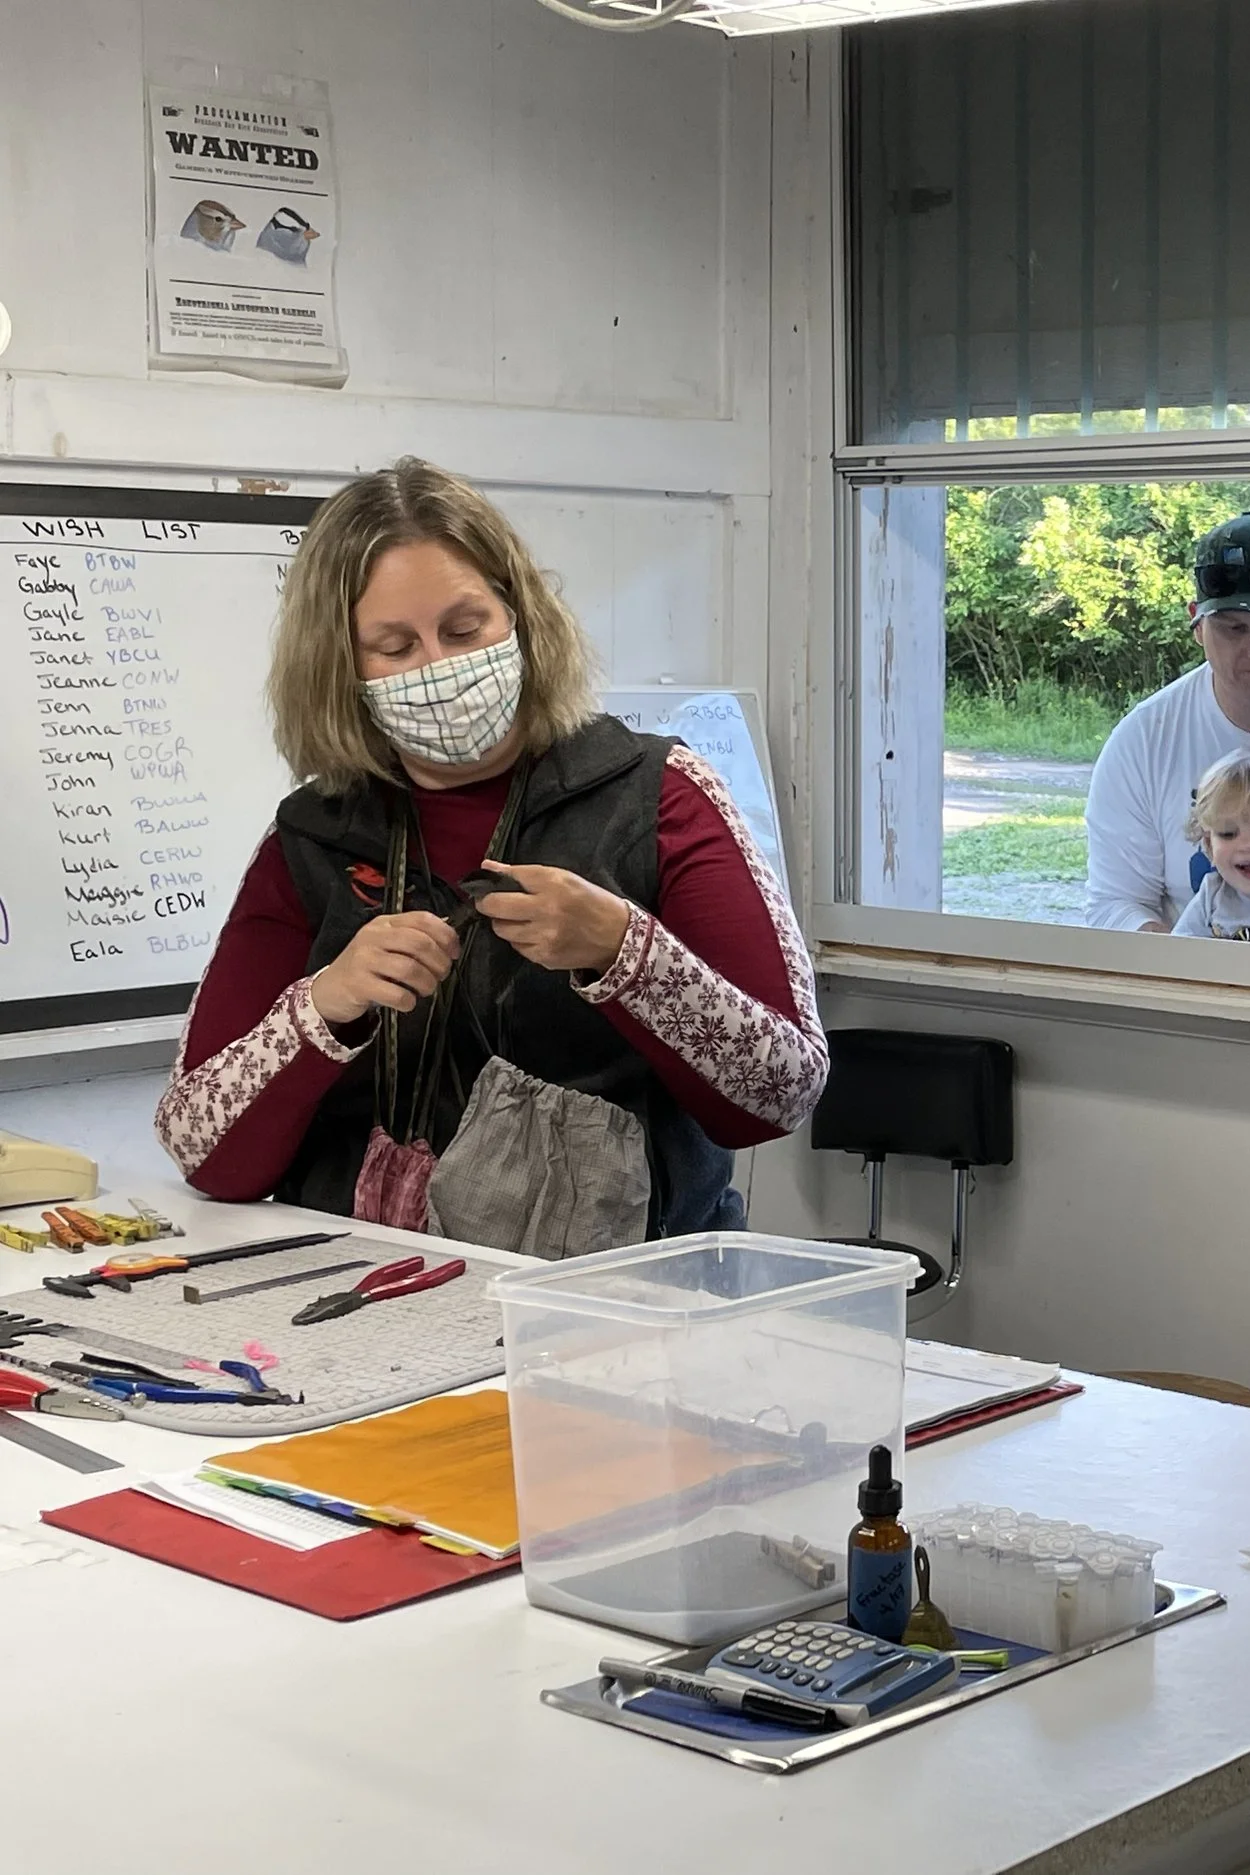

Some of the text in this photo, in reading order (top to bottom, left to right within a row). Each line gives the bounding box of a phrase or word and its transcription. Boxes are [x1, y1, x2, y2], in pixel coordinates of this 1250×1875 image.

[166, 130, 319, 171] WANTED
[23, 519, 200, 540] WISH LIST
[85, 552, 136, 572] BTBW
[18, 577, 78, 606] Gabby
[23, 602, 84, 626] Gayle
[28, 626, 155, 642] Jane EABL
[30, 649, 160, 666] Janet YBCU
[121, 669, 180, 690] CONW
[37, 699, 91, 715] Jenn
[684, 705, 742, 720] RBGR
[41, 719, 172, 738] Jenna TRES
[39, 736, 193, 769] Jeremy COGR
[45, 773, 96, 792] John
[53, 801, 112, 819] Kiran
[58, 816, 209, 845] Kurt BAWW
[61, 846, 203, 883] Lydia CERW
[67, 890, 206, 928] Maisie CEDW
[70, 940, 123, 962] Eala
